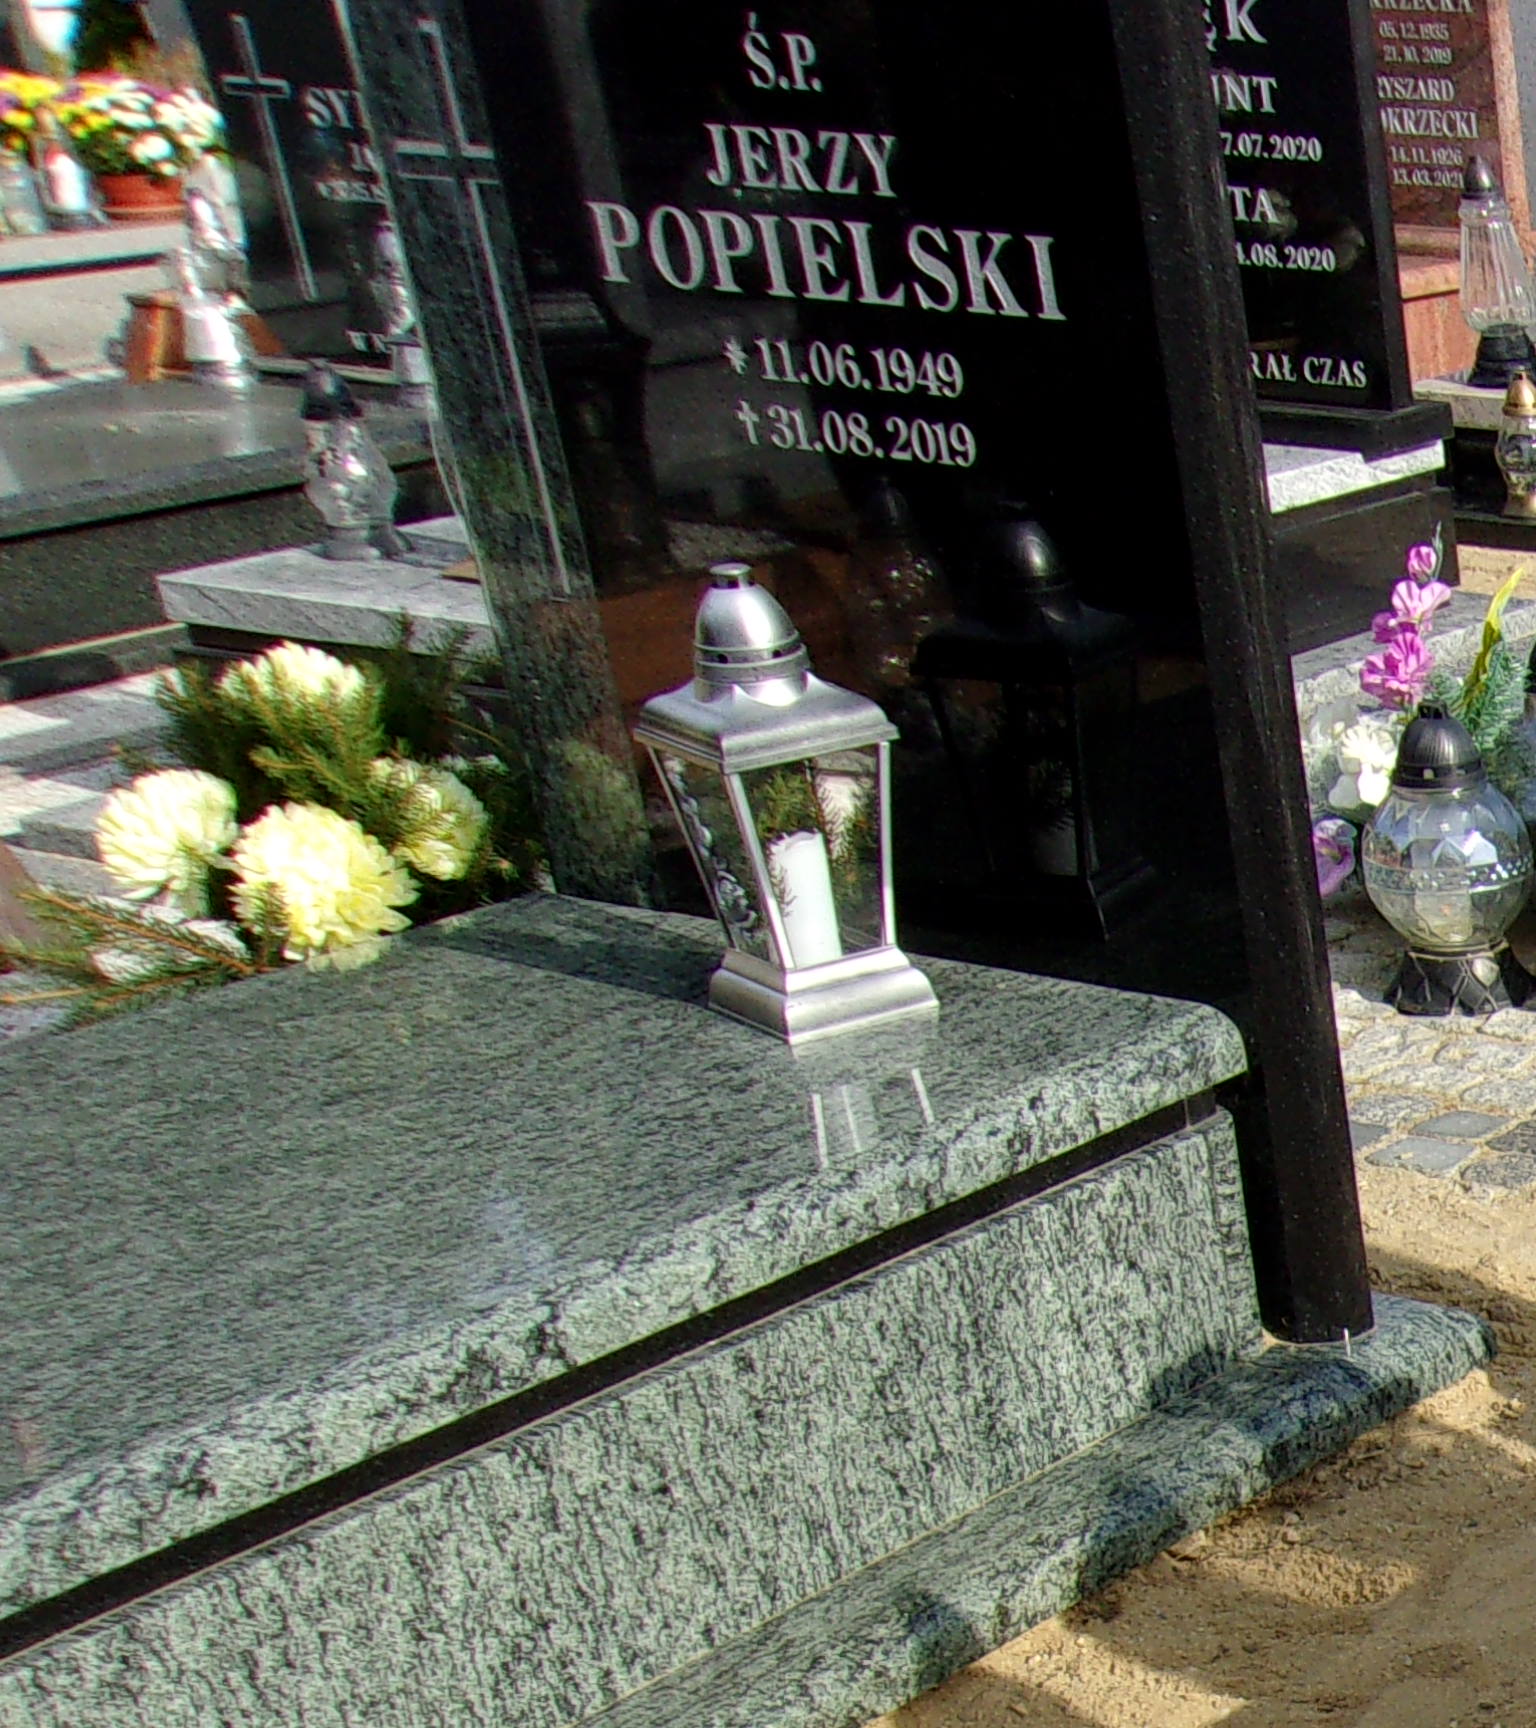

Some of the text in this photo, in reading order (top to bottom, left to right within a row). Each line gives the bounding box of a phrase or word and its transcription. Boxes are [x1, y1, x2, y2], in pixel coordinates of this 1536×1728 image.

[702, 122, 898, 198] JERZY
[586, 200, 1068, 321] POPIELSKI
[754, 336, 965, 398] 11.06.1949
[1303, 356, 1368, 388] CZAS
[769, 403, 977, 468] 31.08.2019
